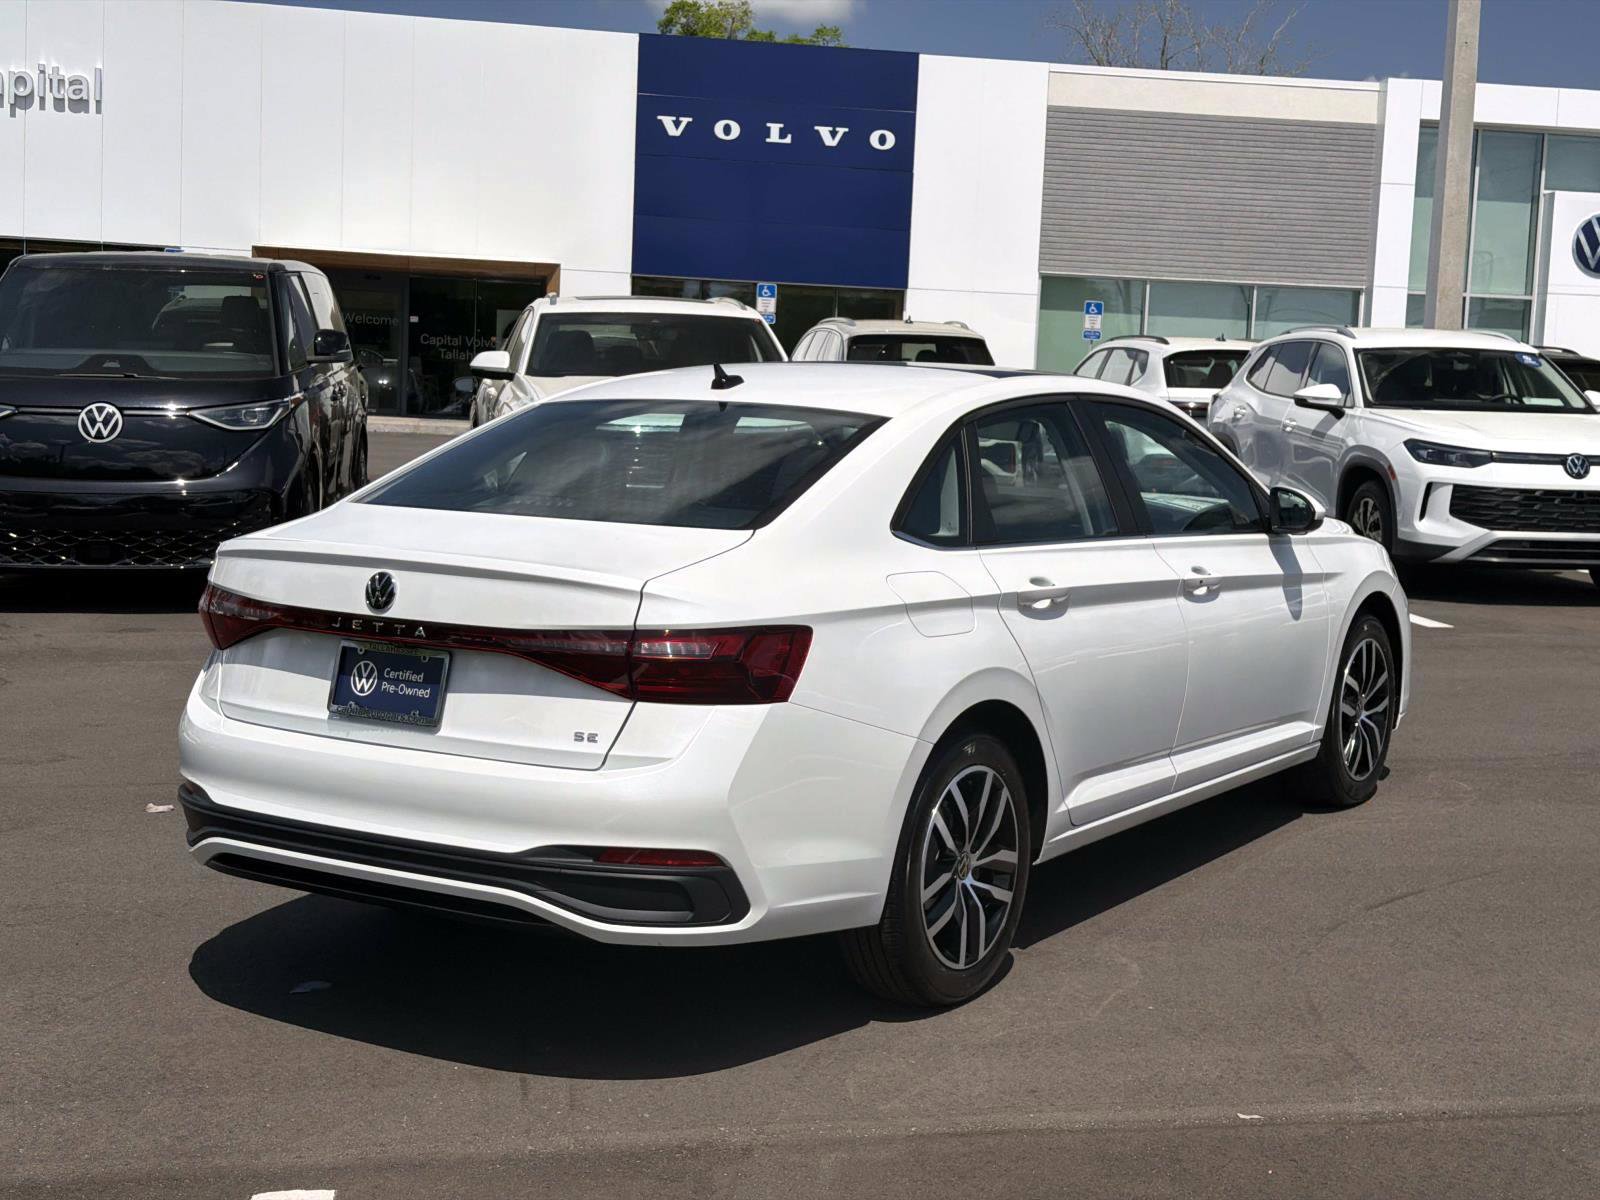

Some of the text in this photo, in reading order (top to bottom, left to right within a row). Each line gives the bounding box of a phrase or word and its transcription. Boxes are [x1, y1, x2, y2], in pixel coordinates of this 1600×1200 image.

[0, 63, 103, 108] pital
[656, 115, 897, 151] VOLVO
[344, 312, 399, 326] Welcome
[420, 333, 462, 347] Capital
[439, 347, 474, 360] Tallah
[331, 617, 426, 637] JETTA
[384, 667, 424, 682] Certified
[381, 682, 430, 698] Pre-Owned
[574, 731, 598, 743] SE
